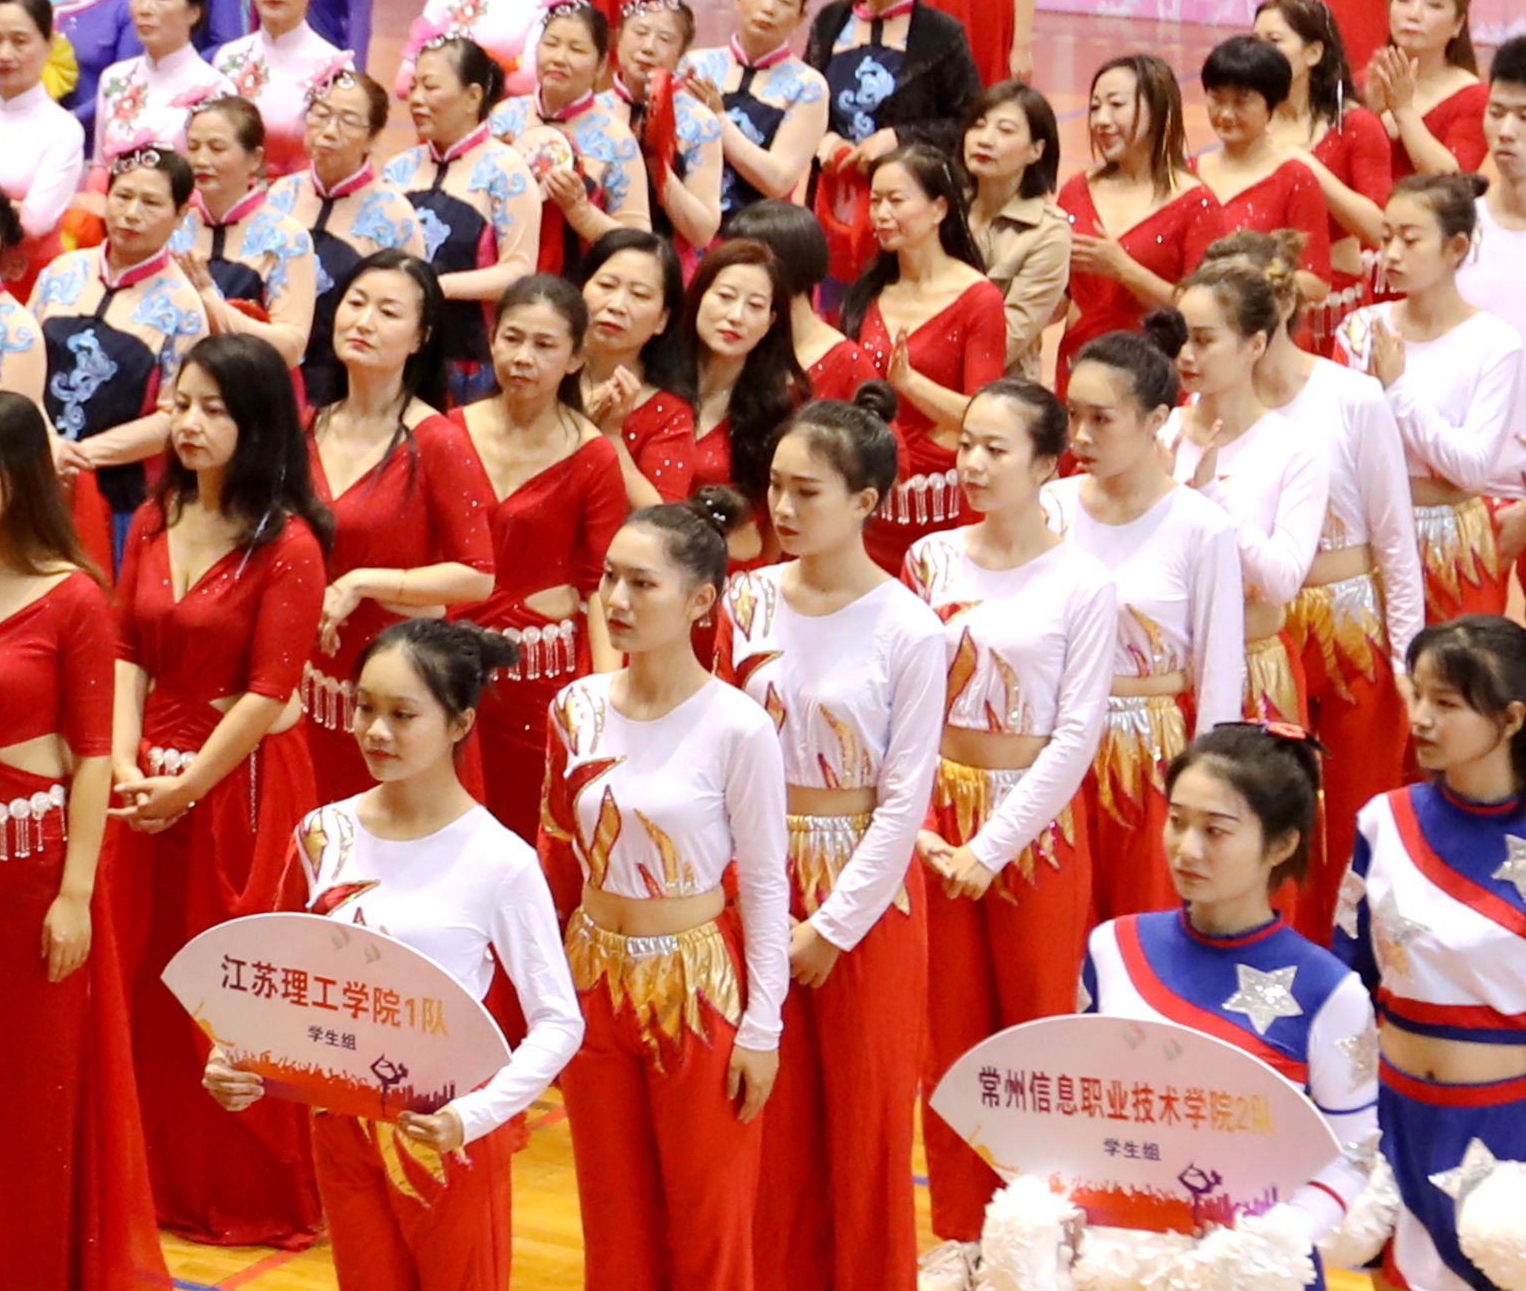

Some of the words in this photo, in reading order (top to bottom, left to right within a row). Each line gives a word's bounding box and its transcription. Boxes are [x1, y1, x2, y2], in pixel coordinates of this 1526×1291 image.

[219, 954, 450, 1038] 江苏理工学院1队
[307, 1024, 358, 1051] 学生组
[978, 1064, 1278, 1135] 常州信息职业技术学院2队
[1102, 1137, 1162, 1162] 学生组
